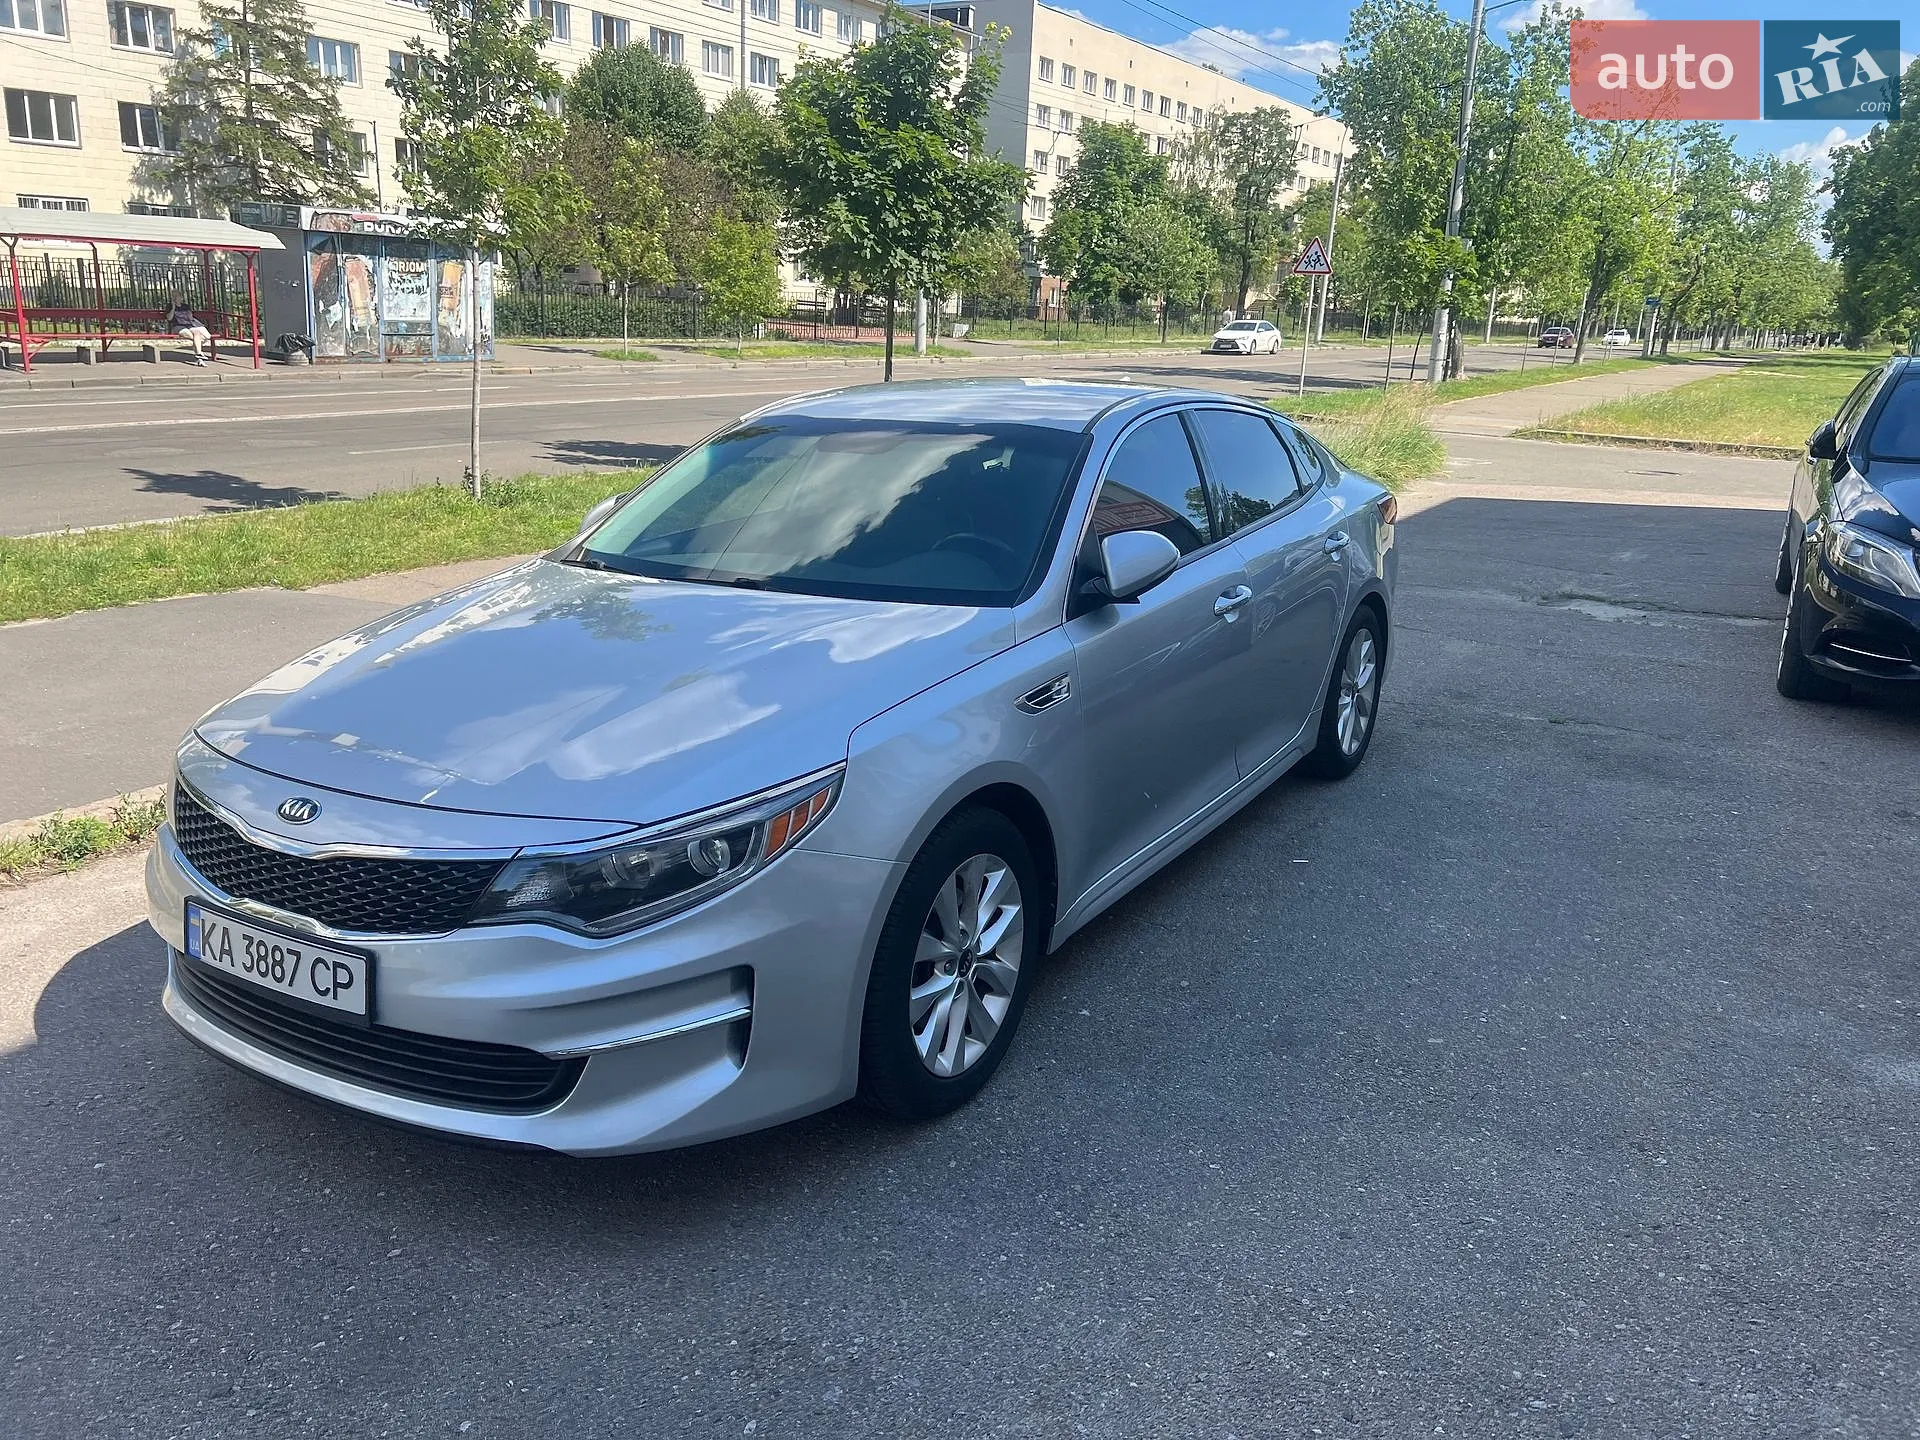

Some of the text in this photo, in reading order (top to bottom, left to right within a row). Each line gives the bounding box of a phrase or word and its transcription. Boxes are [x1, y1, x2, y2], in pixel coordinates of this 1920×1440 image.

[281, 799, 311, 819] KIA
[201, 919, 354, 1000] KA 3887 CP
